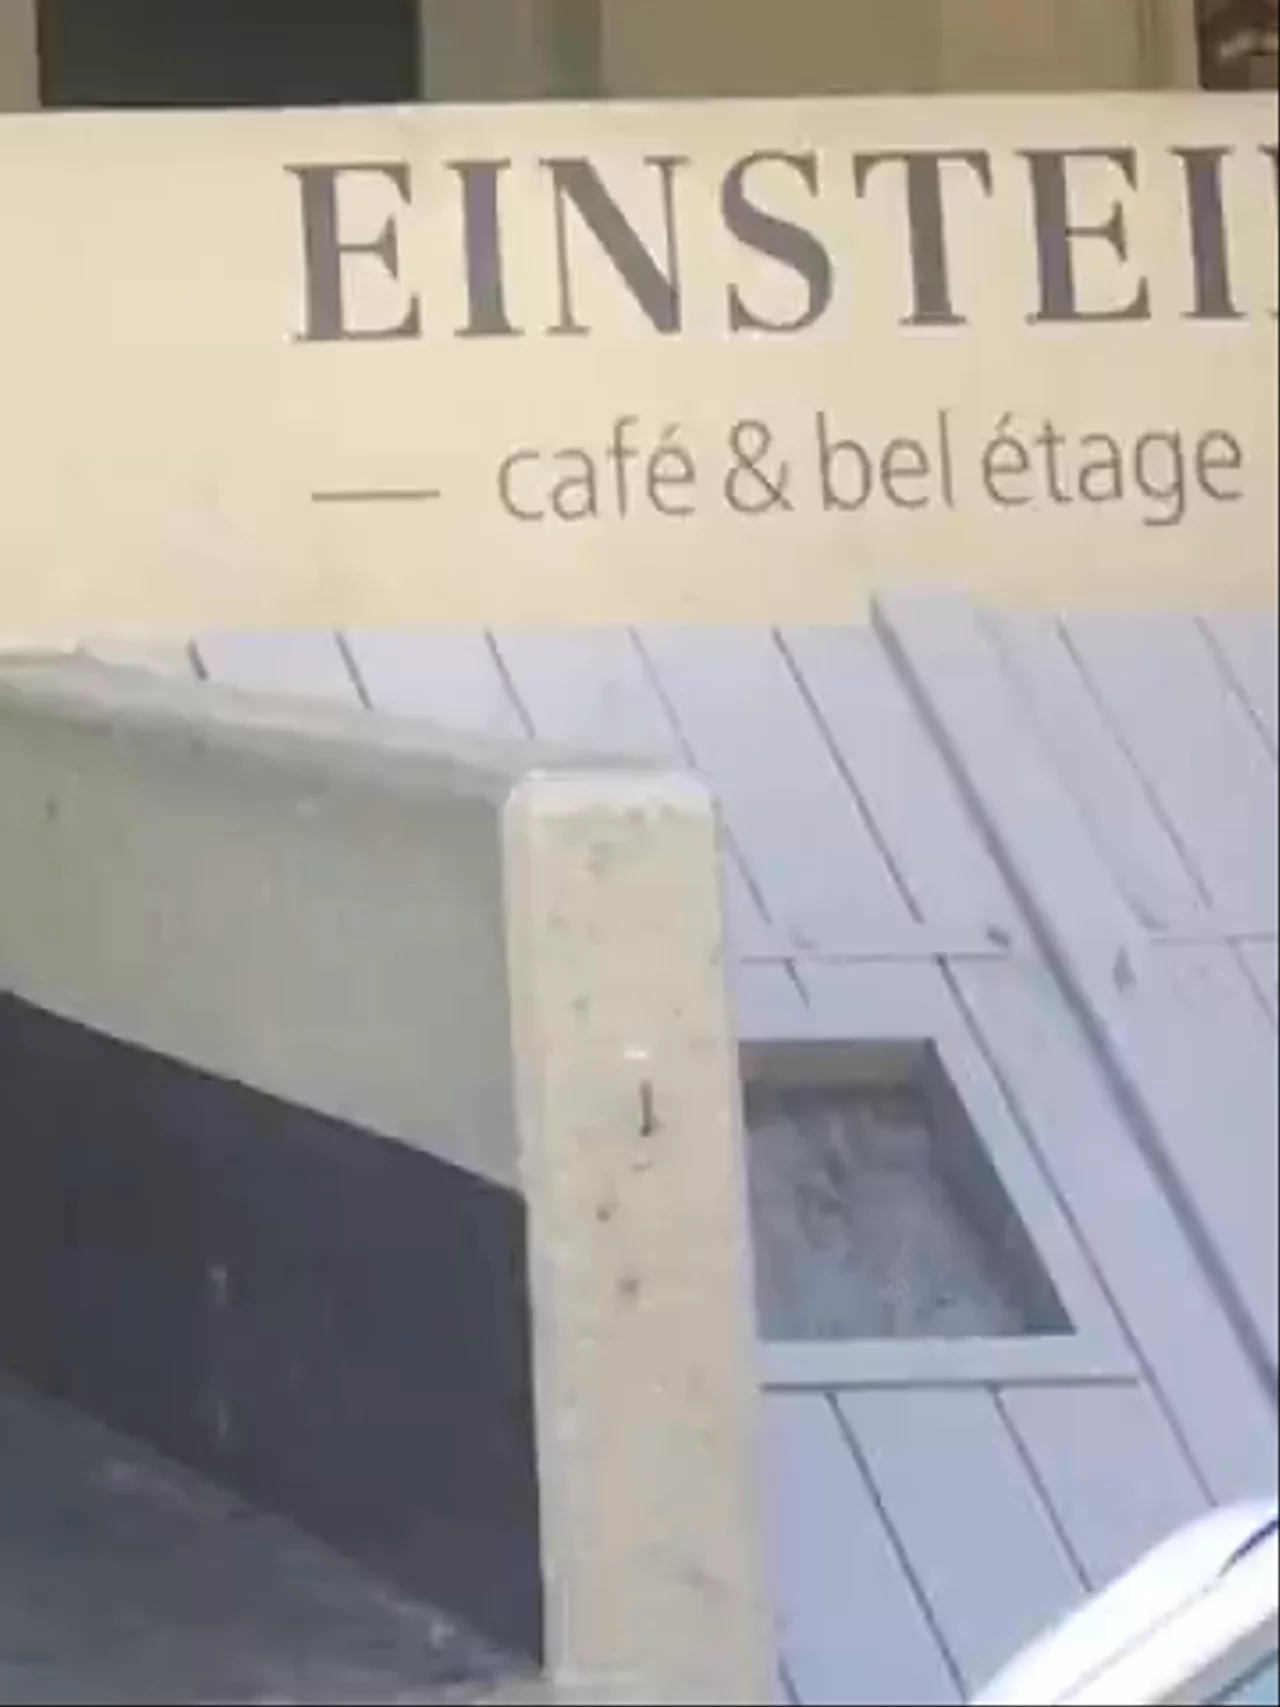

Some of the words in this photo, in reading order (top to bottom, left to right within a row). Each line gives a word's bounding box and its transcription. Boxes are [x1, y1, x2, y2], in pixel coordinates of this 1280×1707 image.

[283, 144, 1278, 343] EINSTEI
[497, 415, 698, 523] café
[723, 419, 794, 515] &
[816, 409, 957, 512] bel
[980, 412, 1246, 528] étage
